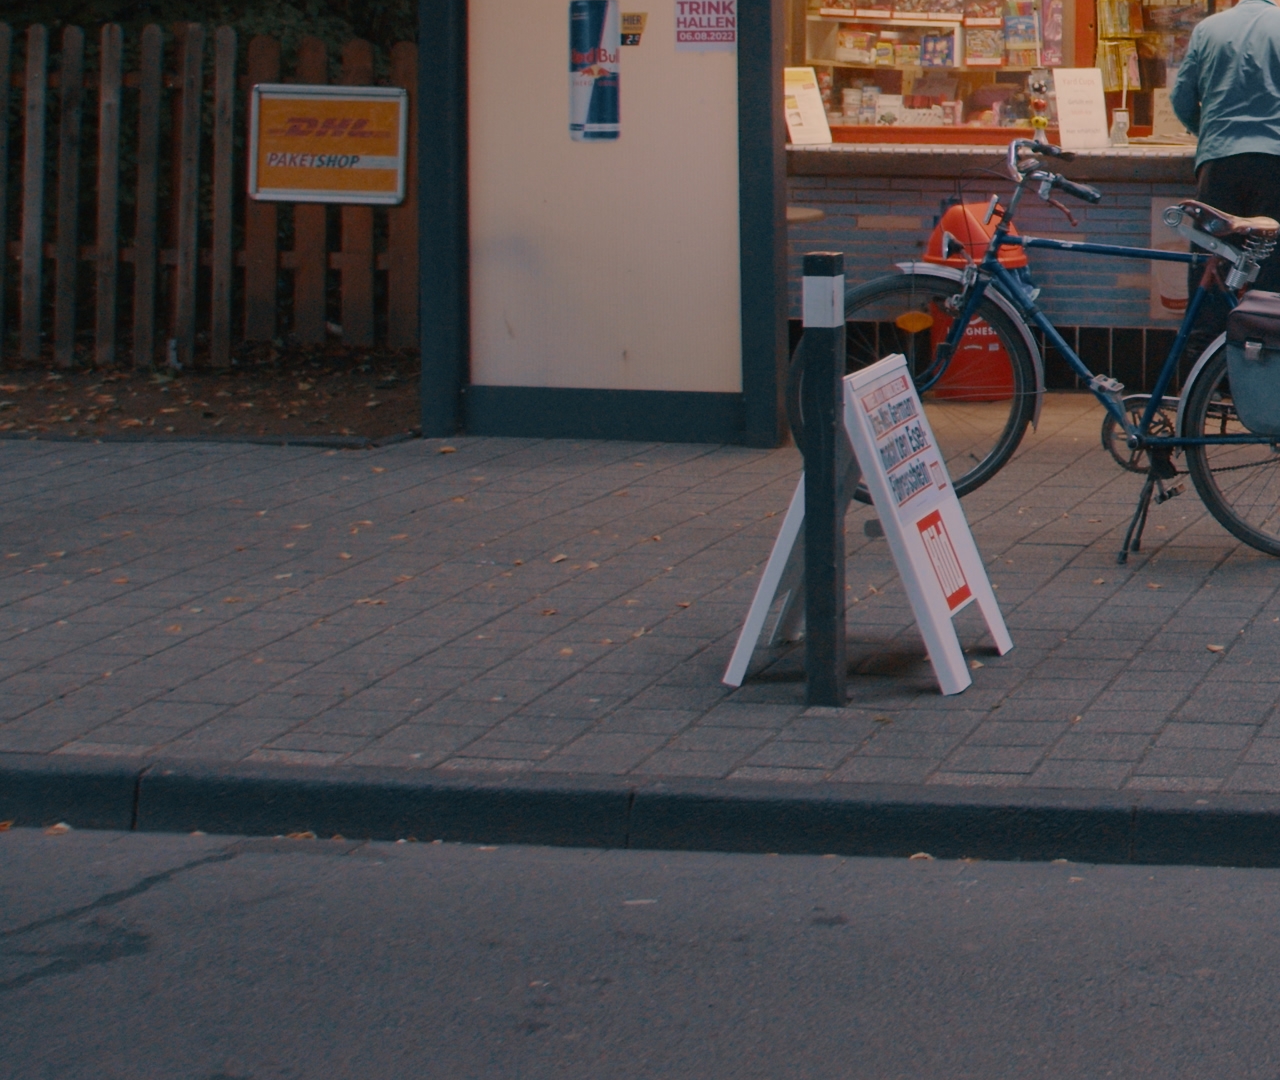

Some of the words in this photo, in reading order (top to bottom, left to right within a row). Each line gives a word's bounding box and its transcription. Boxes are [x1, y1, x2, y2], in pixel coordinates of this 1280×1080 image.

[677, 1, 735, 15] TRINK
[677, 17, 735, 28] HALLEN
[680, 32, 734, 40] 06.08.2022
[285, 117, 375, 138] DHL
[268, 153, 360, 168] PAKETSHOP
